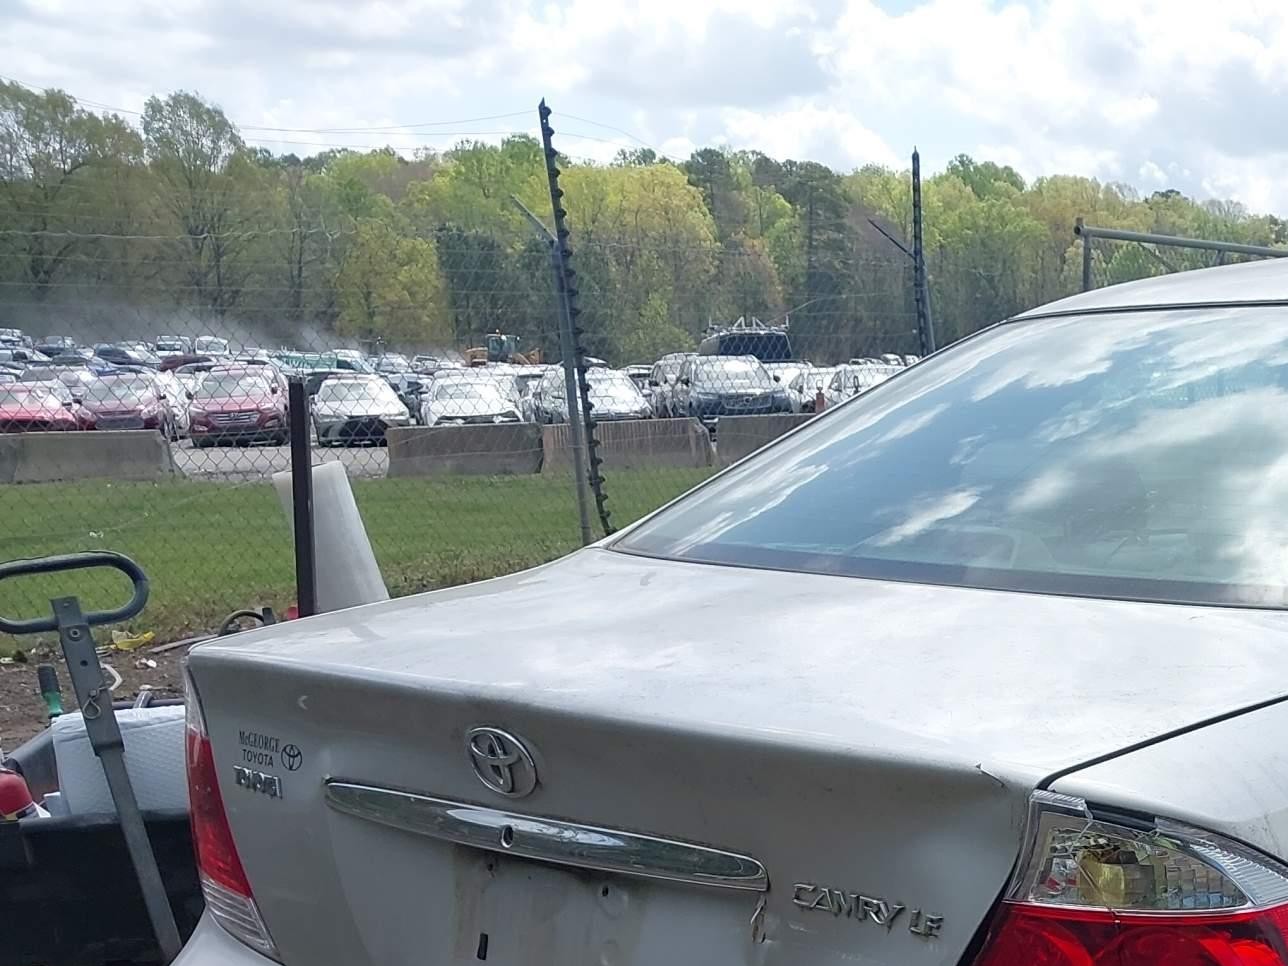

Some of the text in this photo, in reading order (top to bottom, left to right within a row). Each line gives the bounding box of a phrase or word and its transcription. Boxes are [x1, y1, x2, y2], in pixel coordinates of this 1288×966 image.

[239, 730, 280, 754] McGEORGE
[242, 748, 274, 769] TOYOTA
[792, 882, 945, 939] CAMRY LE
